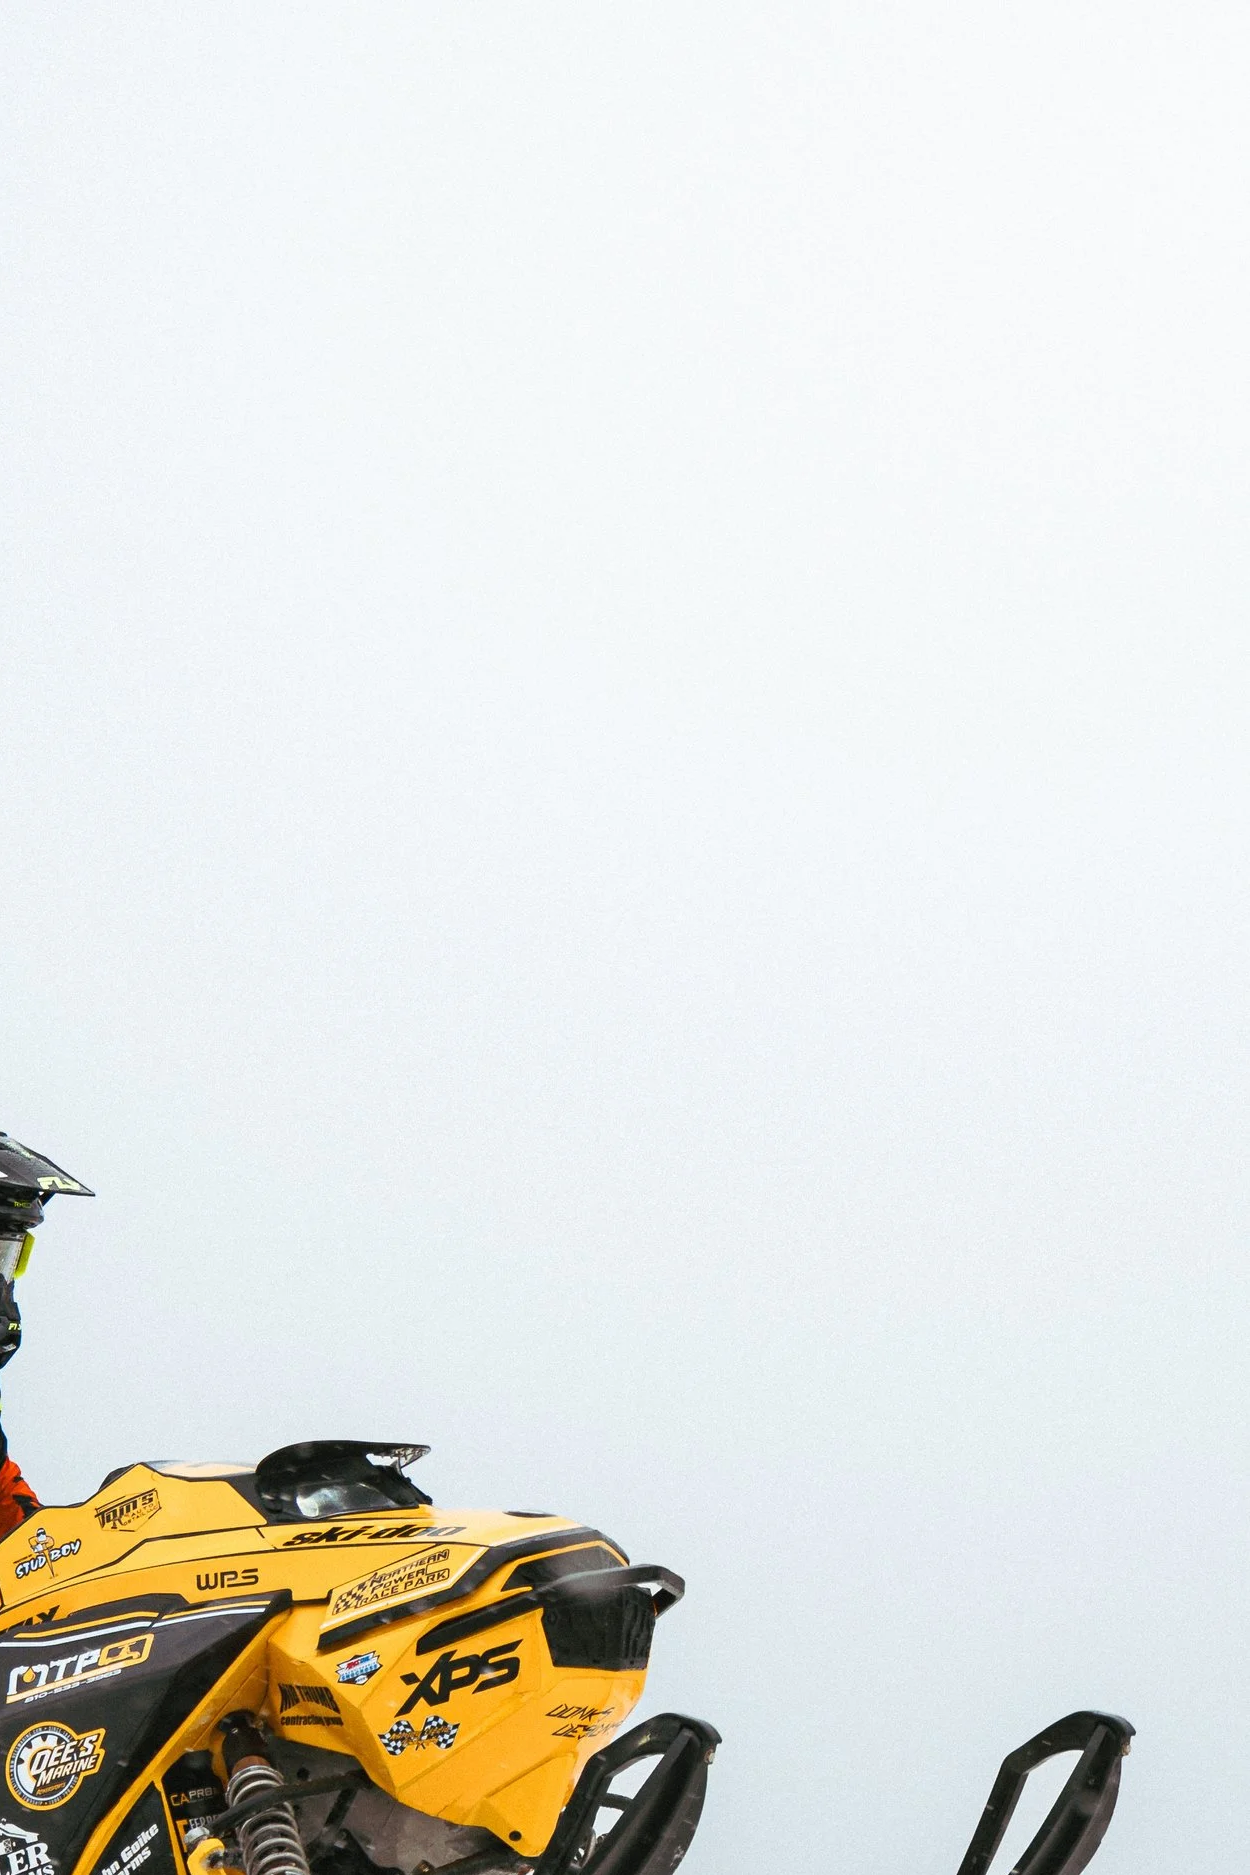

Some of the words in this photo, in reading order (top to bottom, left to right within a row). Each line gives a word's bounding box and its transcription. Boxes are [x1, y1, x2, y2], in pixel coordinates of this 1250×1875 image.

[15, 1553, 46, 1579] STUD
[49, 1538, 82, 1562] BOY
[196, 1569, 259, 1592] WPS
[359, 1583, 400, 1606] RACE
[403, 1569, 447, 1590] PARK
[370, 1568, 425, 1595] POWER
[394, 1638, 524, 1719] XPS
[36, 1755, 98, 1788] MARINE
[120, 1823, 159, 1863] Goike
